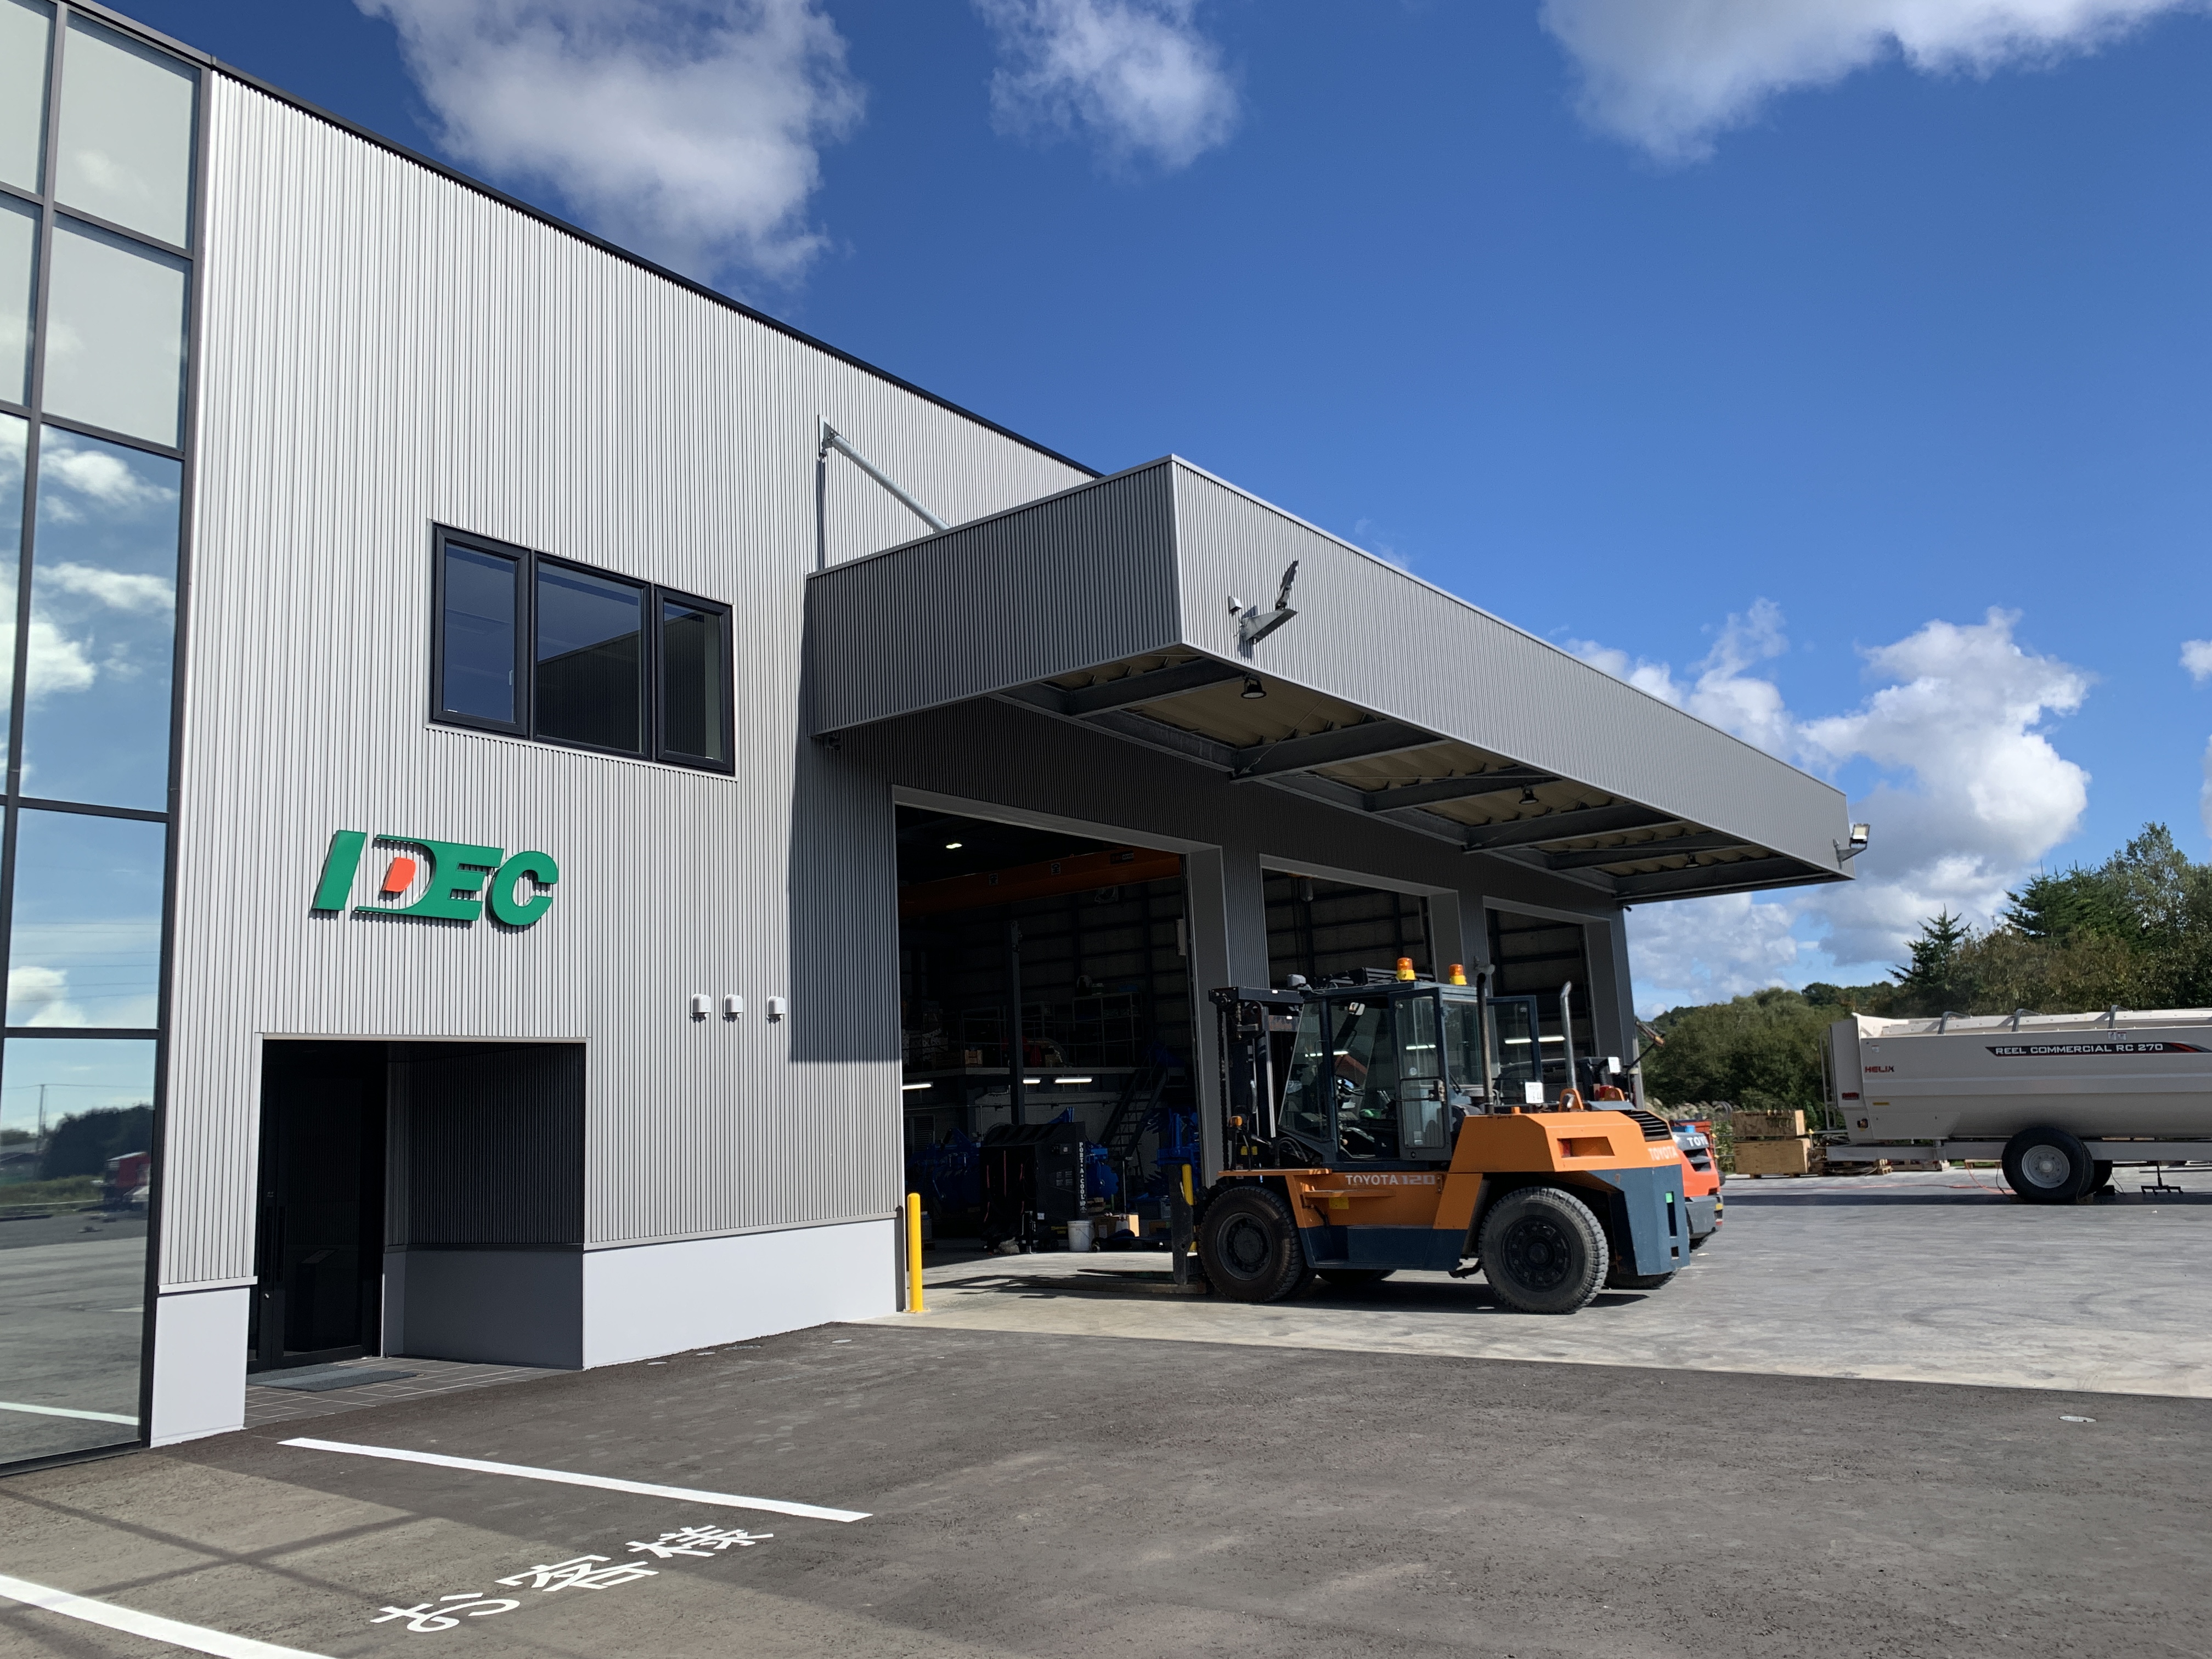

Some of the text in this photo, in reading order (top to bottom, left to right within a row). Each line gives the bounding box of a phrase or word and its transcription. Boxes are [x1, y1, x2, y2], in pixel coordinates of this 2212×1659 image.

[312, 830, 559, 926] IDEC
[1995, 1043, 2163, 1055] REEL COMMERCIAL RC 270
[1647, 1146, 1680, 1161] TOYOTA
[1345, 1175, 1435, 1186] TOYOTA 120
[370, 1524, 774, 1633] お客様
